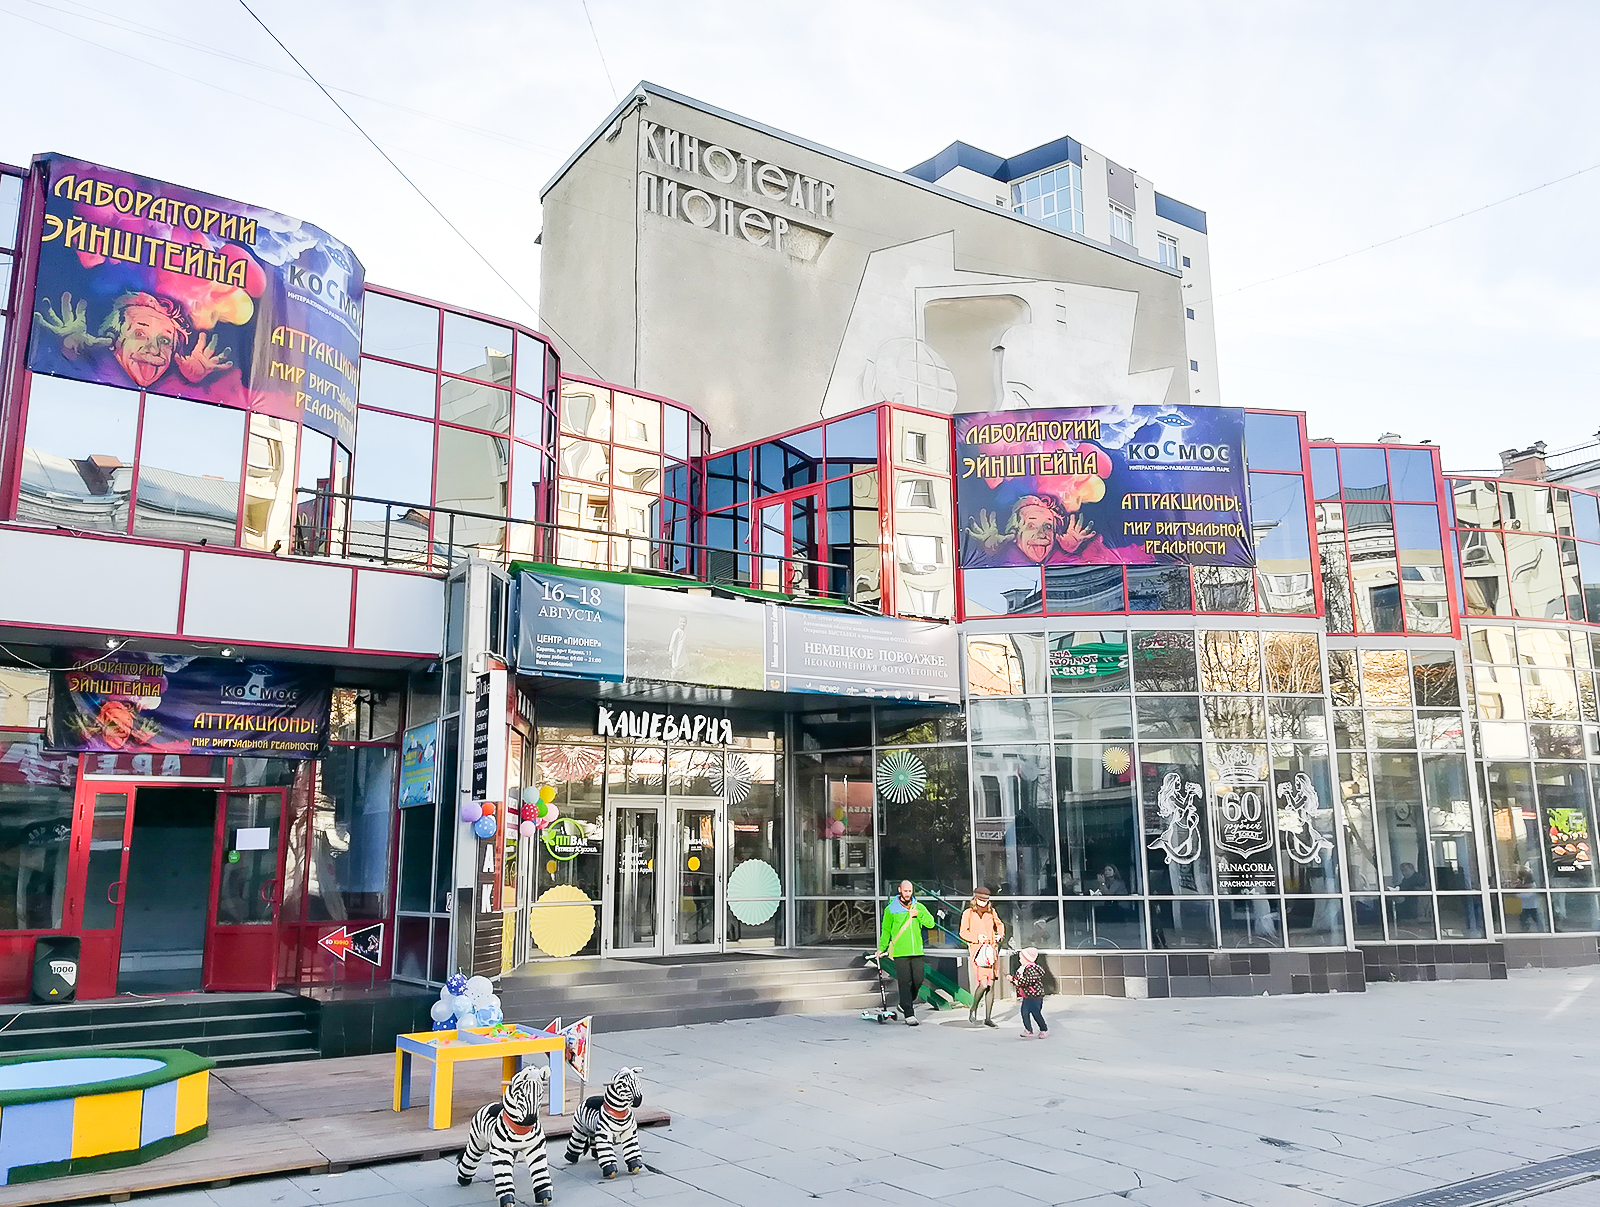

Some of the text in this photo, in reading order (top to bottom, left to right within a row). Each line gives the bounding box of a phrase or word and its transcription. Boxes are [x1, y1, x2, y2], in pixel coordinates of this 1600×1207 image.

[54, 174, 259, 245] ЛАБОРАТОРИИ
[41, 213, 247, 287] ЭЙНШТЕЙНА
[269, 360, 306, 384] МИР
[965, 419, 1101, 445] ЛАБОРАТОРИИ
[1128, 440, 1230, 461] КОСМОС
[962, 450, 1098, 479] ЭЙНШТЕЙНА
[1121, 493, 1243, 512] АТТРАКЦИОНЫ:
[1123, 521, 1246, 538] МИР ВИРТУАЛЬНОЙ
[1145, 540, 1227, 555] РЕАЛЬНОСТИ
[538, 605, 603, 623] АВГУСТА
[536, 634, 602, 647] ЦЕНТР «ПИОНЕР»
[828, 629, 857, 639] ВЫСТАВКИ
[804, 642, 948, 667] НЕМЕЦКОЕ ПОВОЛЖЬЕ.
[72, 660, 164, 676] ЛАБОРАТОРИИ
[804, 658, 949, 678] НЕОКОНЧЕННАЯ ФОТОЛЕТОПИСЬ
[69, 677, 161, 697] ЭЙНШТЕЙНА
[220, 684, 299, 701] КОСМОС
[194, 712, 319, 734] АТТРАКЦИОНЫ:
[597, 706, 733, 745] КАШЕВАРНЯ
[191, 737, 319, 750] МИР ВИРТУАЛЬНОЙ РЕАЛЬНОСТИ
[1221, 792, 1262, 822] 60
[1223, 819, 1263, 835] рублей
[52, 965, 74, 974] 1000
